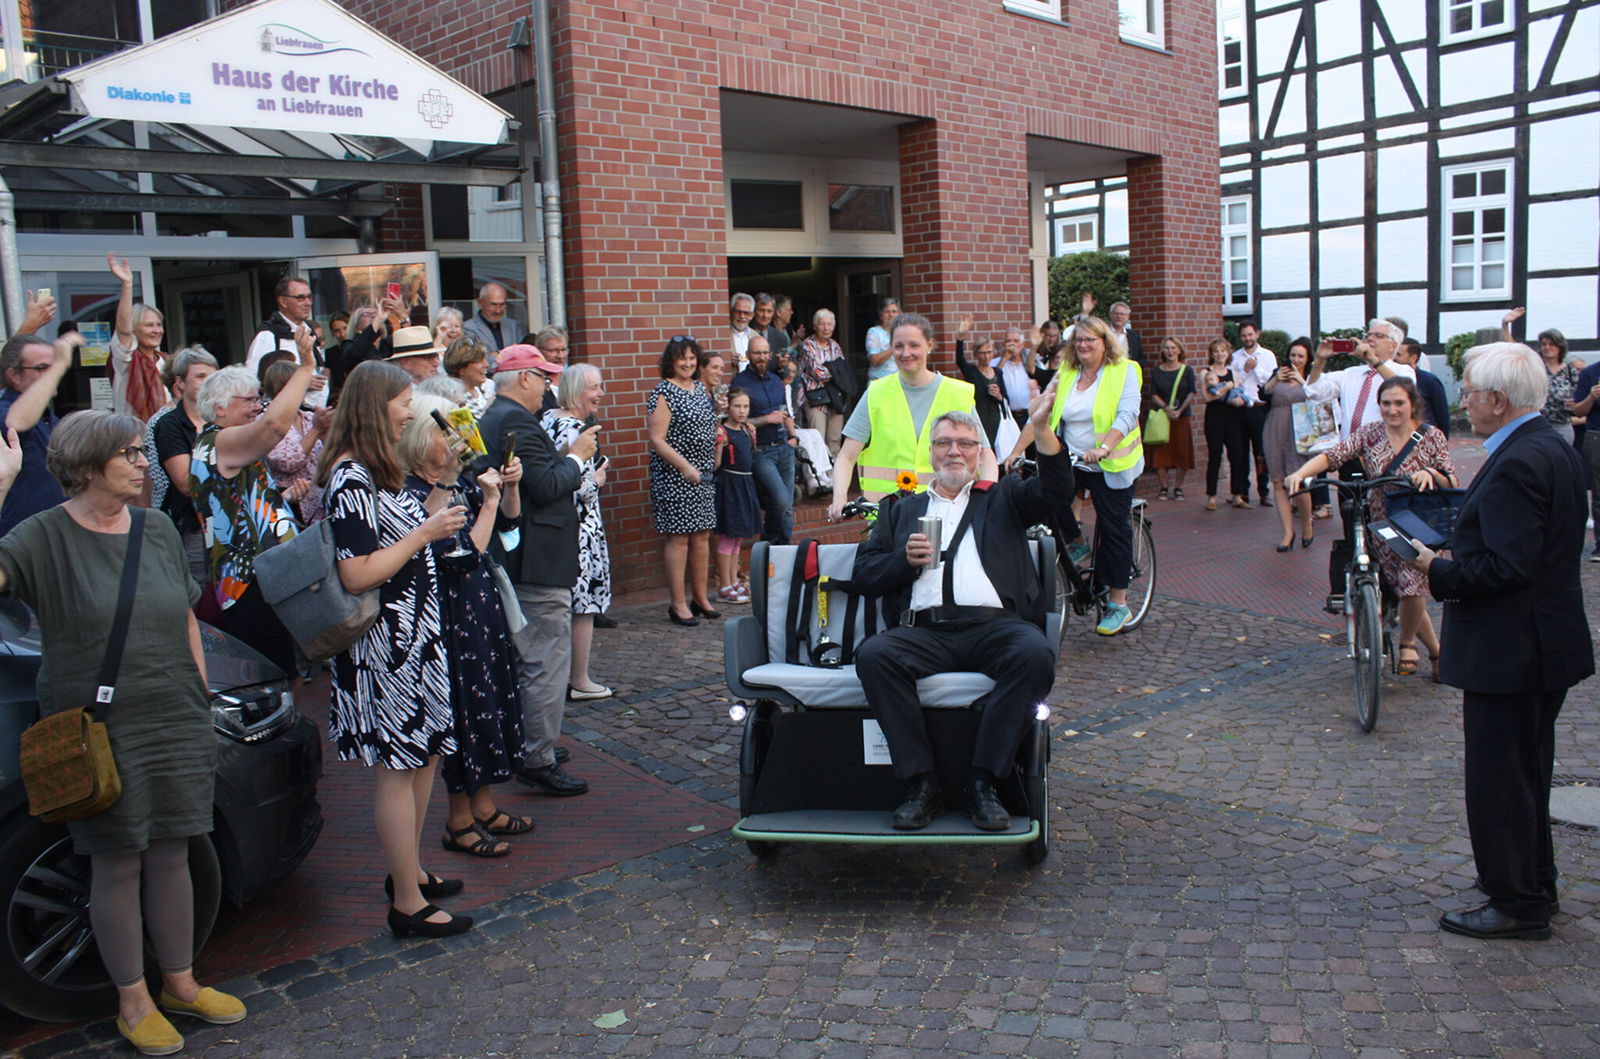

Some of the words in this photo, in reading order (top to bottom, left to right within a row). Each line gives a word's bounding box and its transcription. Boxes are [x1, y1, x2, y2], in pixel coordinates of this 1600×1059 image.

[275, 36, 324, 50] Liebfrauen
[212, 62, 272, 90] Haus
[281, 70, 320, 94] der
[328, 74, 399, 101] Kirche
[107, 86, 176, 103] Diakonie
[256, 98, 276, 111] an
[282, 97, 363, 118] Liebfrauen
